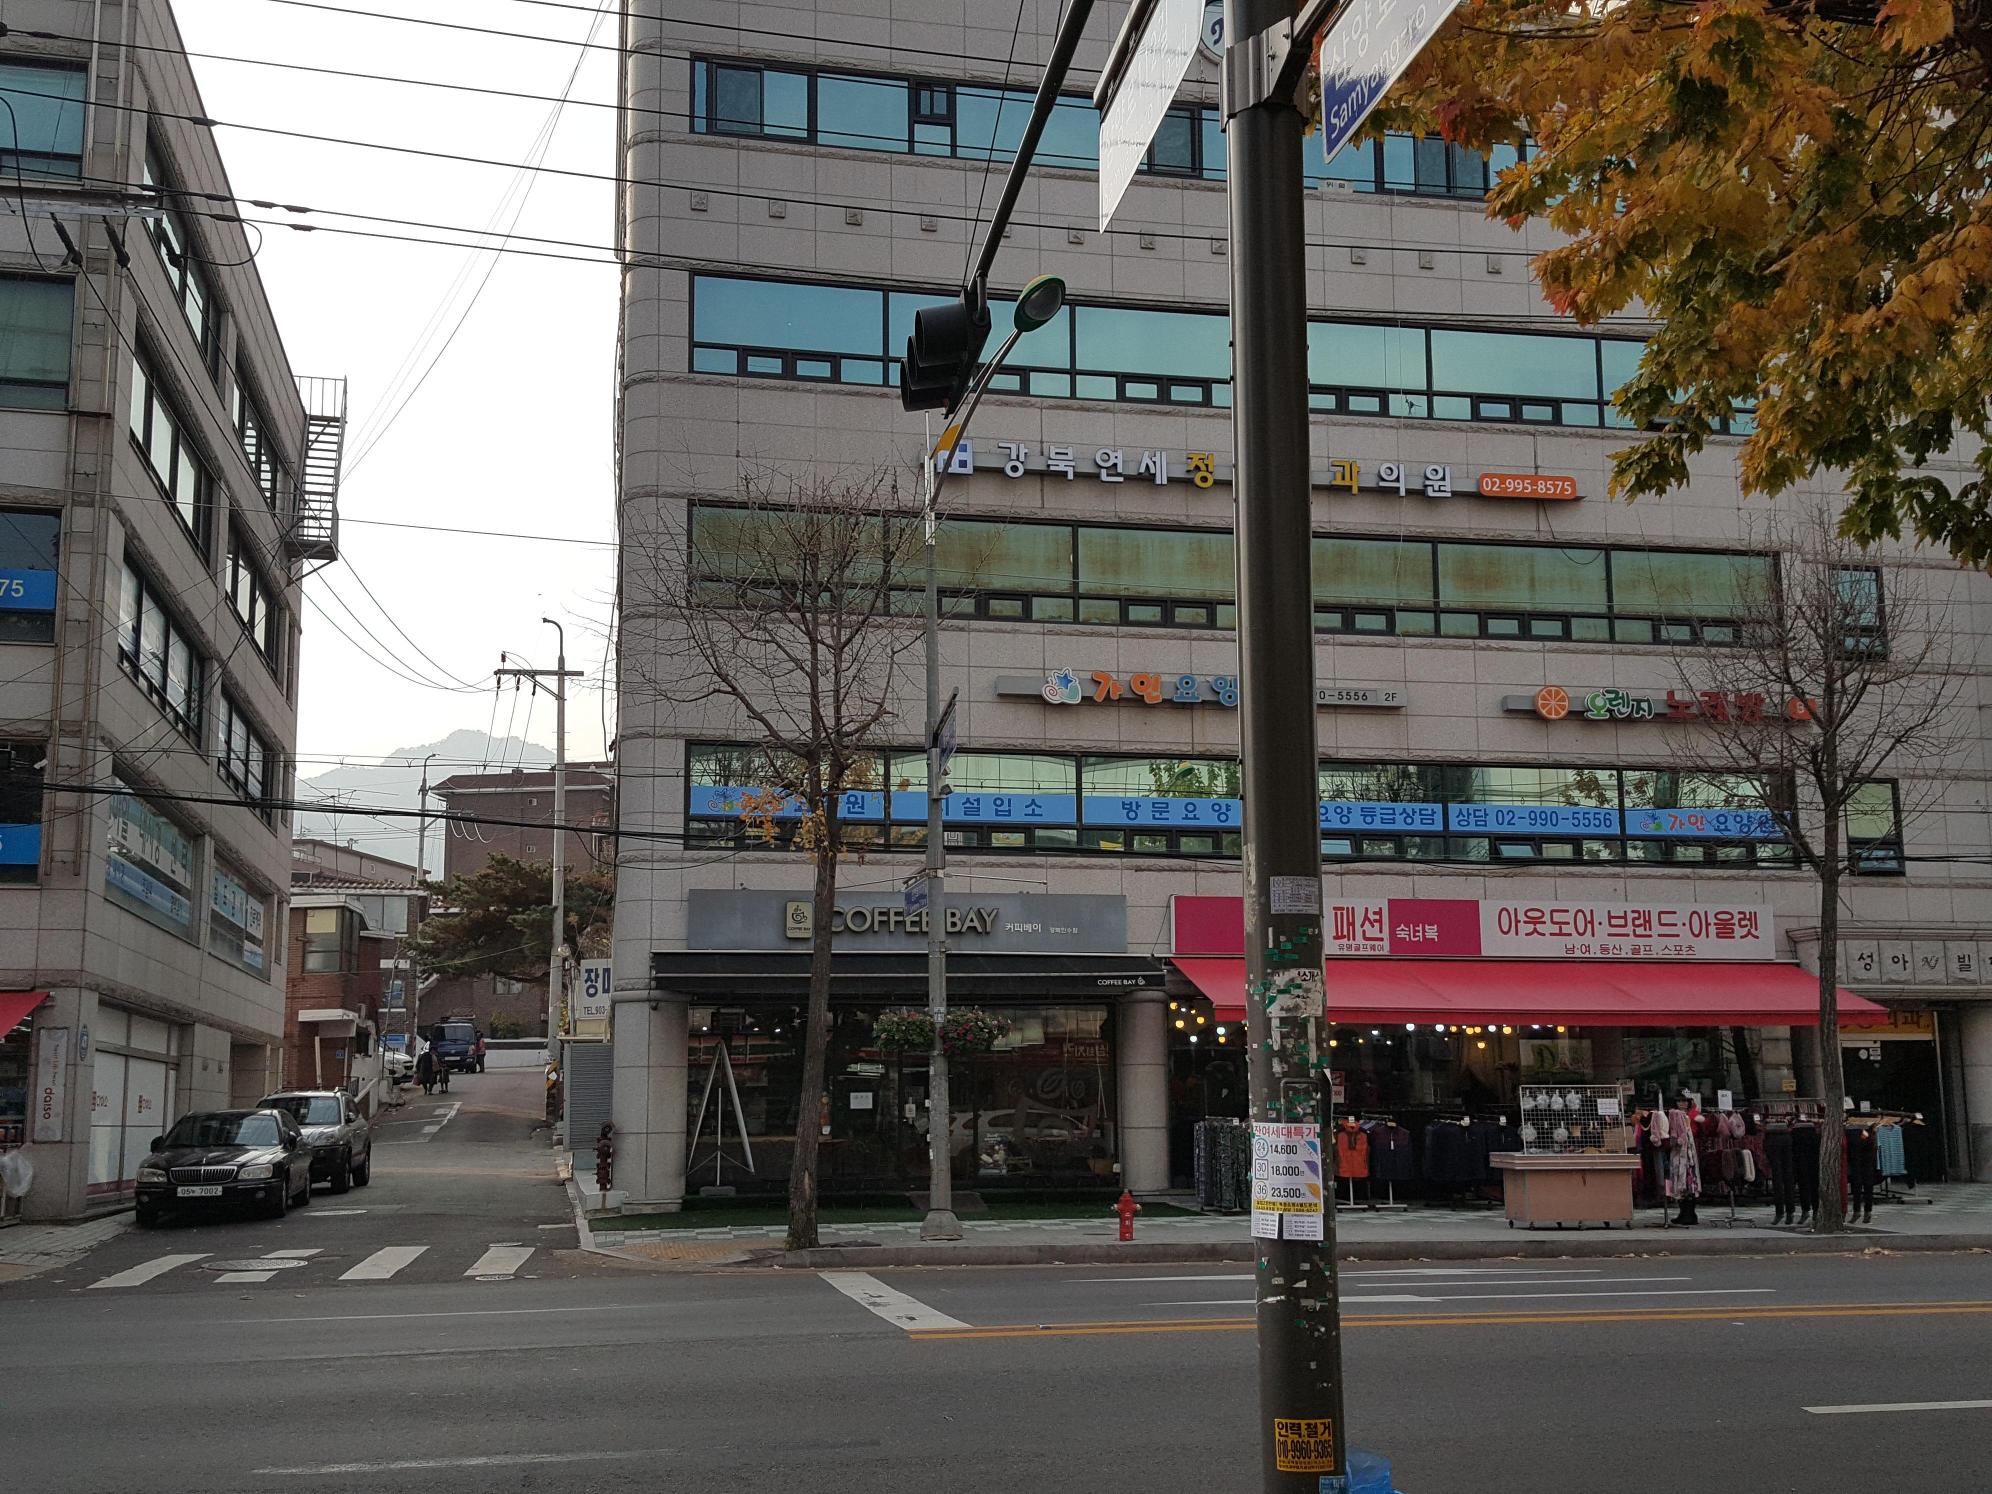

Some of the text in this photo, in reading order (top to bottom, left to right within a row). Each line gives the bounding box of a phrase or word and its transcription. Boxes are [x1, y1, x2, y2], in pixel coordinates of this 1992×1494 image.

[1482, 477, 1572, 495] 02-995-8575
[1091, 672, 1238, 707] 가인 요양
[1315, 690, 1397, 702] 0-5556 2F
[1584, 687, 1655, 720] 오렌지
[941, 795, 1044, 818] 설입소
[1121, 800, 1232, 824] 방문요양
[1359, 806, 1437, 827] 등급상담
[1455, 807, 1613, 829] 상담 02-990-5556
[1667, 812, 1706, 832] 가인
[945, 907, 999, 933] BAY
[1332, 906, 1385, 942] 패션
[1395, 923, 1439, 943] 숙녀복
[43, 1087, 55, 1120] daiso
[1269, 1144, 1298, 1155] 14,600
[1257, 1162, 1267, 1172] 30
[199, 1186, 219, 1195] 7002
[1257, 1185, 1267, 1195] 36
